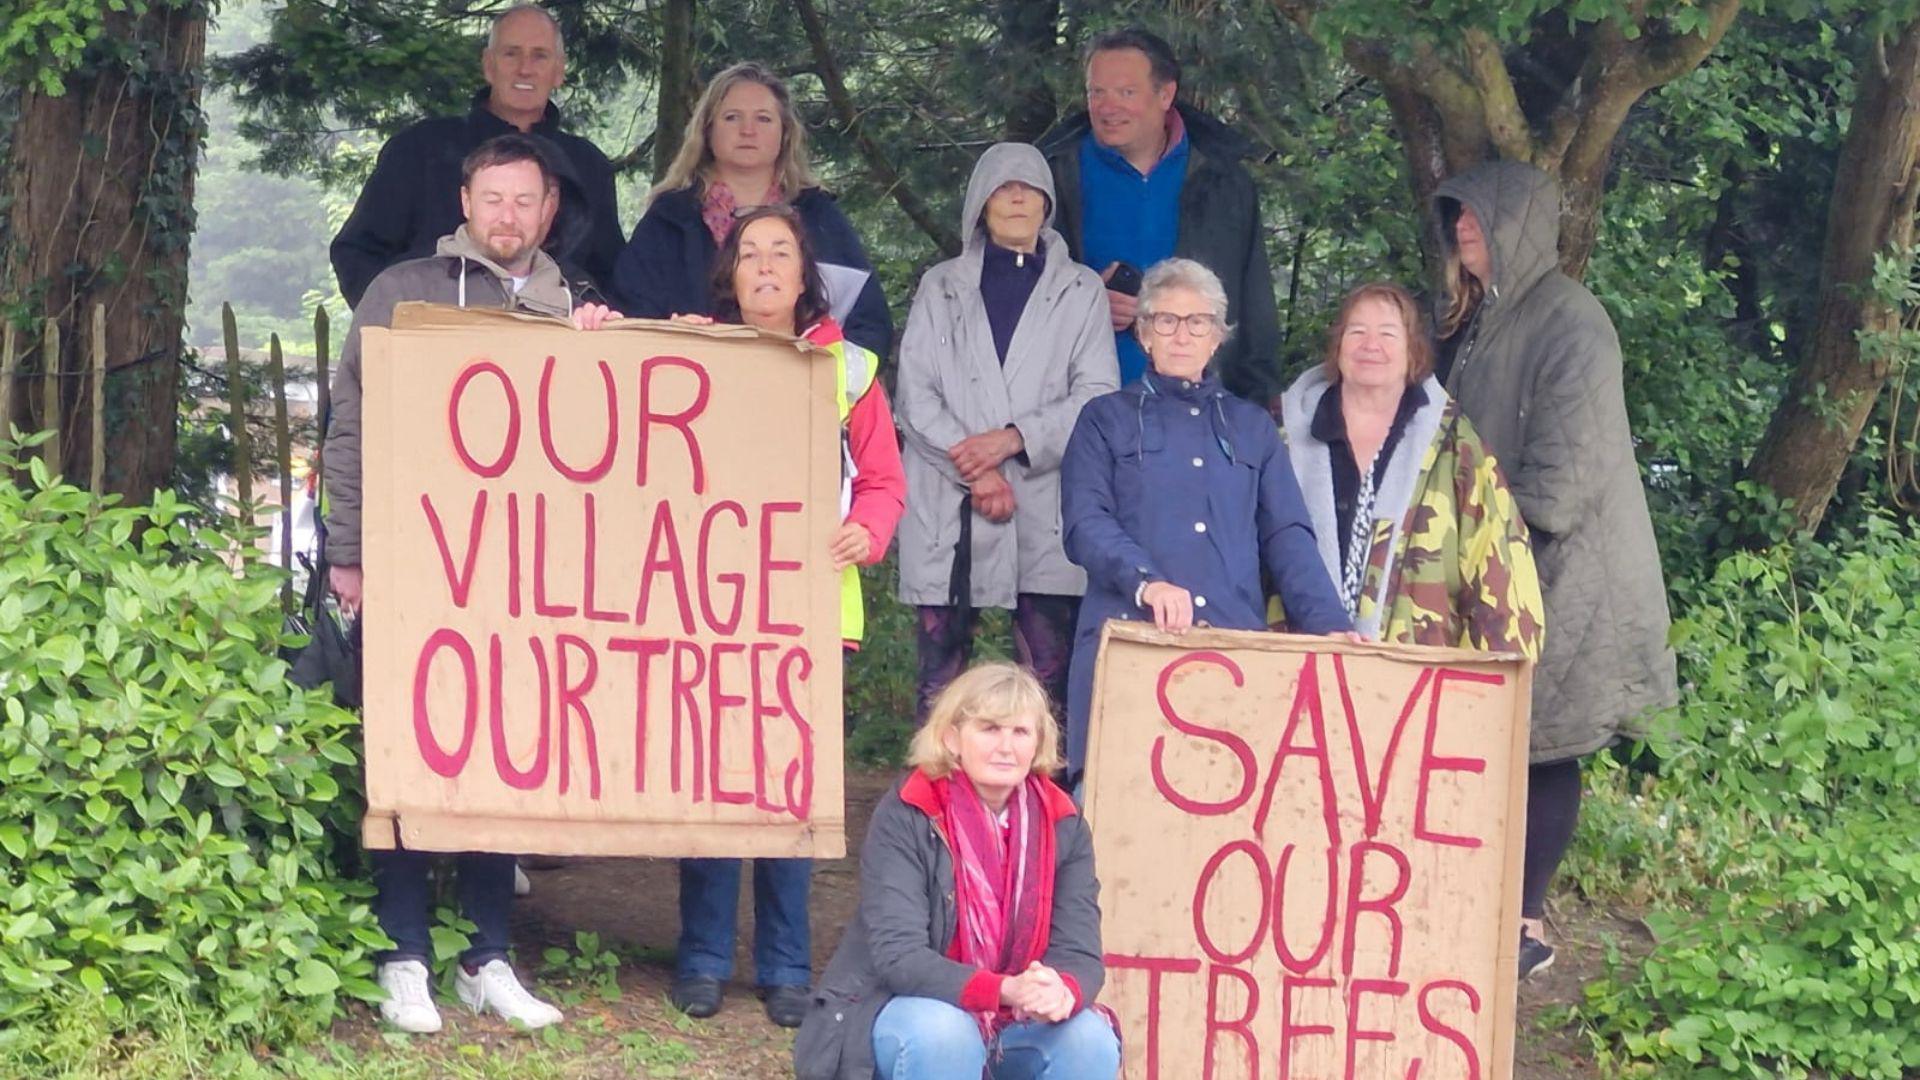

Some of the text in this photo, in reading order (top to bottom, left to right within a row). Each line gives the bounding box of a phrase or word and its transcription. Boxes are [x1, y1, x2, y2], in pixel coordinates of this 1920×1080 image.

[451, 355, 710, 494] OUR
[421, 490, 803, 636] VILLAGE
[413, 629, 814, 821] OUR TREES
[1151, 651, 1505, 847] SAVE
[1193, 839, 1411, 978] OUR
[1104, 953, 1481, 1080] TREES
